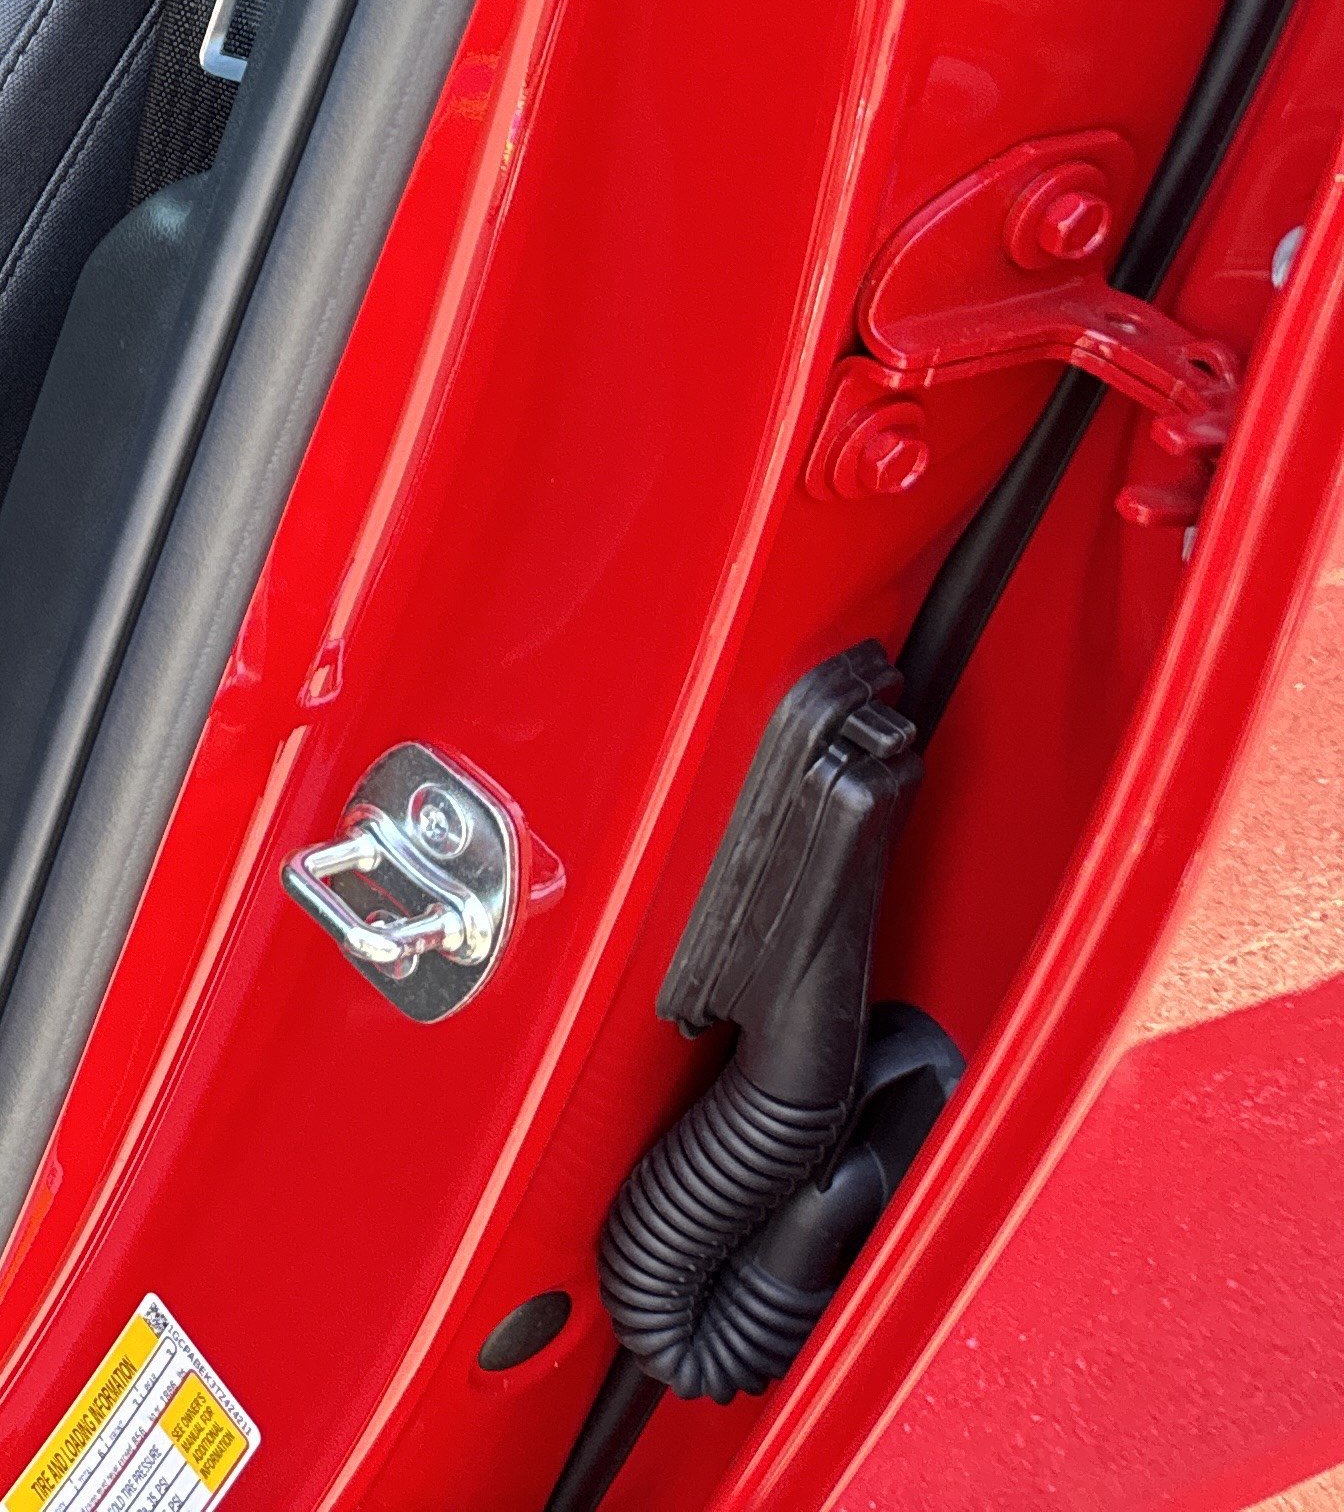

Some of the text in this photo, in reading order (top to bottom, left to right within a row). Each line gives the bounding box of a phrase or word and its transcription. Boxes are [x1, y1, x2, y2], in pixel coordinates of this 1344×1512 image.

[167, 1324, 252, 1436] 1GCPABEK3TZ424211
[30, 1470, 56, 1502] TIRE
[47, 1452, 69, 1483] AND
[60, 1413, 97, 1464] LOADING
[87, 1354, 138, 1425] INFORMATION
[172, 1422, 186, 1442] SEE
[181, 1405, 215, 1453] MANUAL FOR
[192, 1420, 224, 1464] ADDITIONAL
[132, 1444, 162, 1485] PRESSURE
[199, 1428, 236, 1480] INFORMATION
[155, 1476, 171, 1497] PSI
